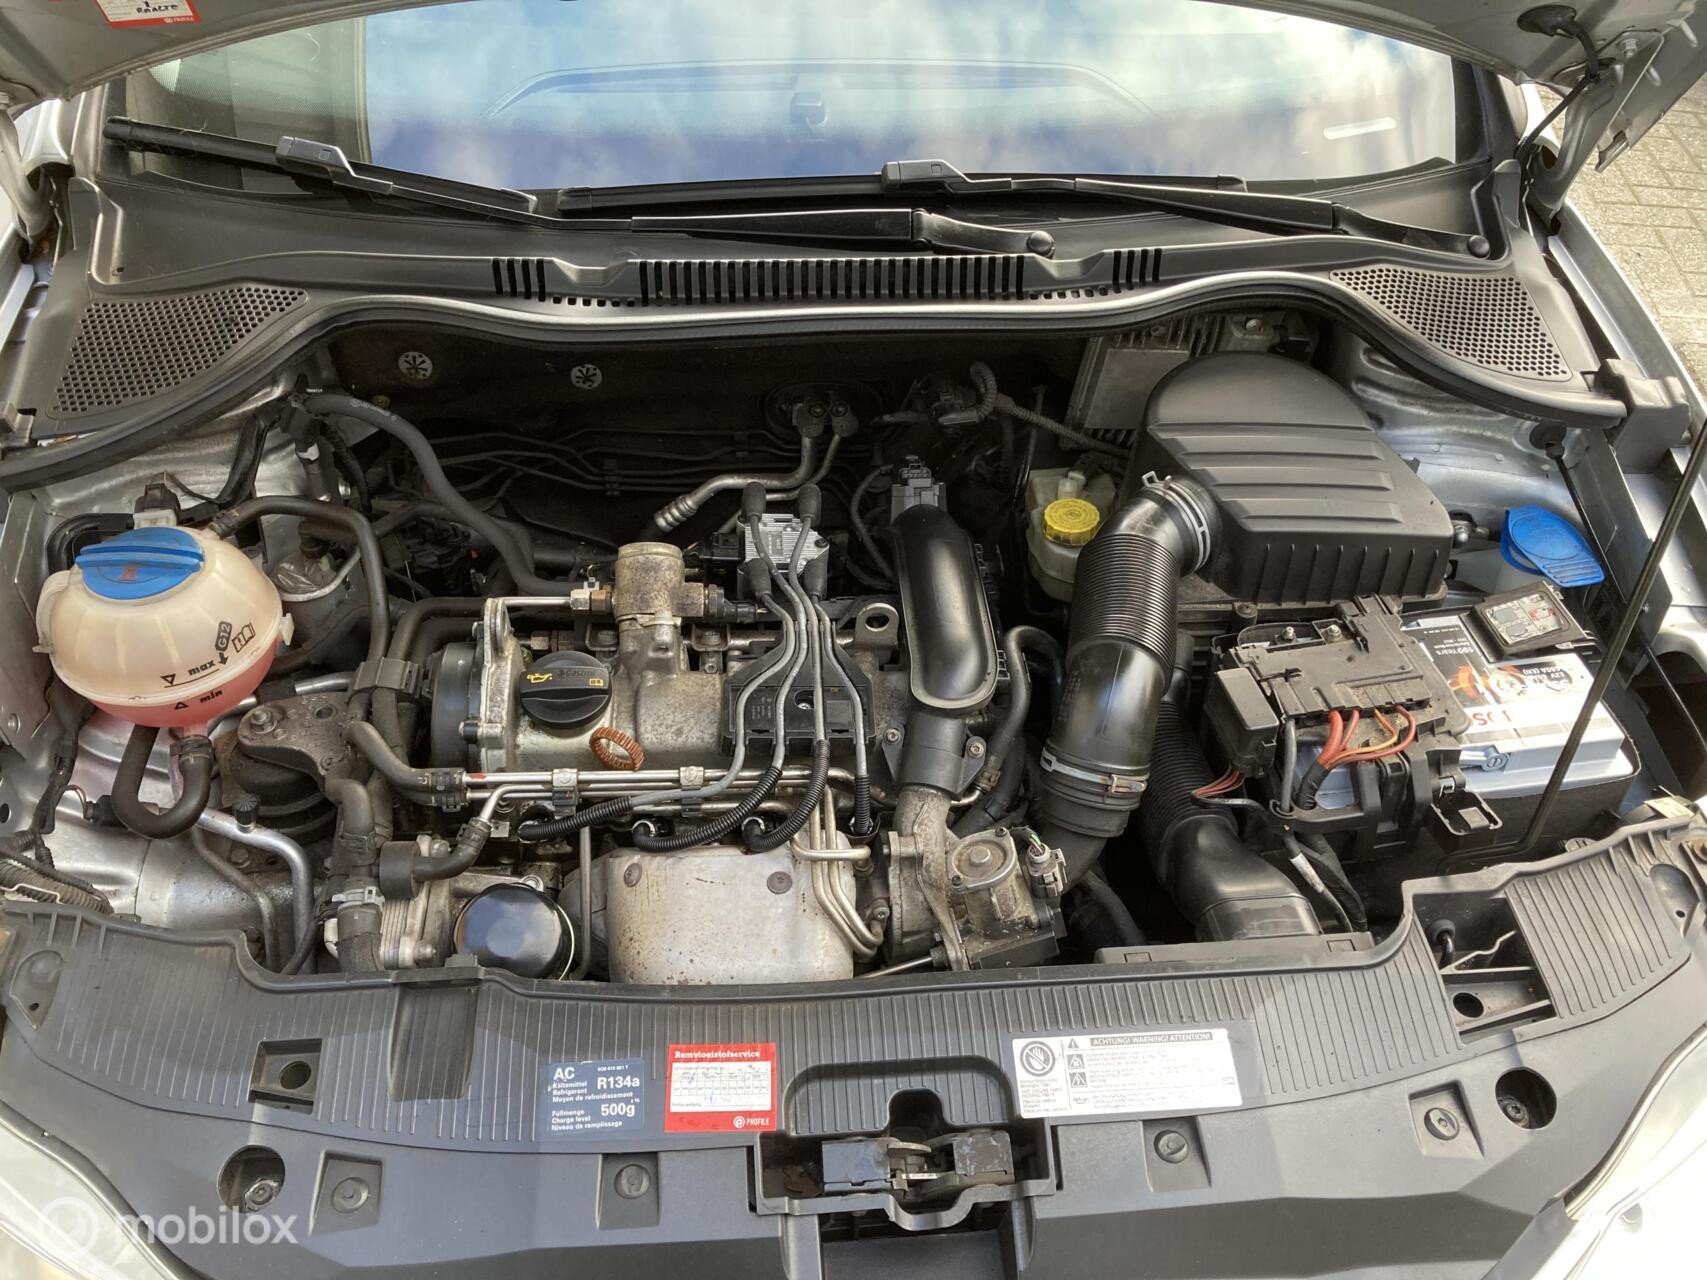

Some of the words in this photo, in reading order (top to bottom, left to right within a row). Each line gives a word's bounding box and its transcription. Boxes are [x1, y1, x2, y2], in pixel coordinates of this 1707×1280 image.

[217, 623, 230, 648] G12
[188, 660, 216, 675] max
[200, 690, 223, 703] min
[674, 1049, 760, 1059] Remvloeistofservice
[553, 1066, 575, 1080] AC
[597, 1075, 640, 1089] R134a
[552, 1088, 588, 1096] Refrigerant
[552, 1095, 574, 1103] Moyen
[585, 1091, 633, 1100] refroidissement
[600, 1102, 635, 1117] 500g
[551, 1117, 574, 1125] Charge
[585, 1120, 623, 1129] remplissage
[746, 1117, 769, 1126] PROFILE
